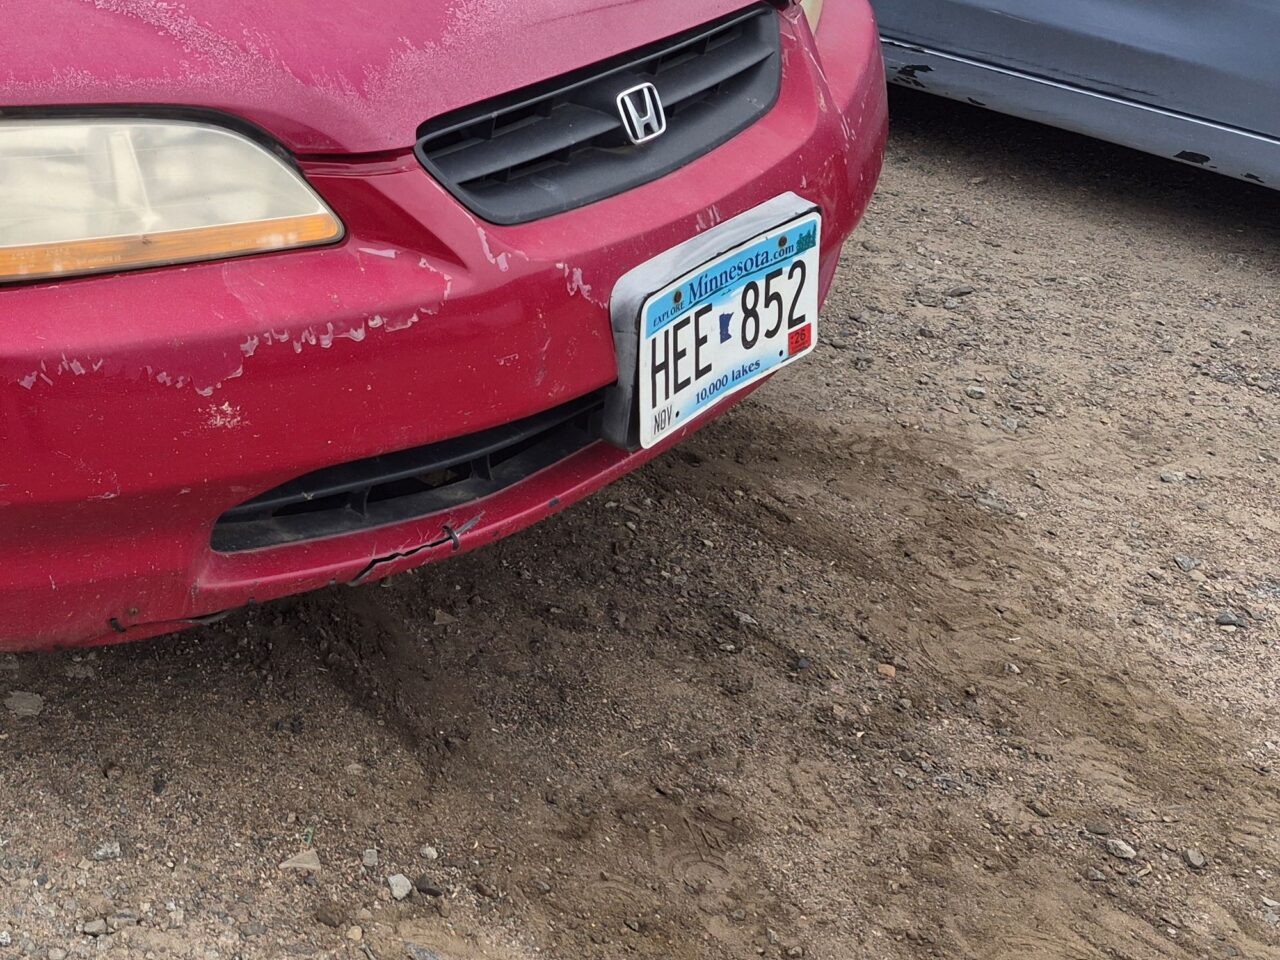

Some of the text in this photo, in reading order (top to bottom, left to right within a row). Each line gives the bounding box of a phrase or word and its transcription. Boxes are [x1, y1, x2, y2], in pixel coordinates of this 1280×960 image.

[653, 245, 795, 328] EXPLORE Minnesota.com
[650, 259, 807, 409] HEE 852
[695, 358, 761, 406] 10,000 lakes
[653, 405, 673, 435] NOV
